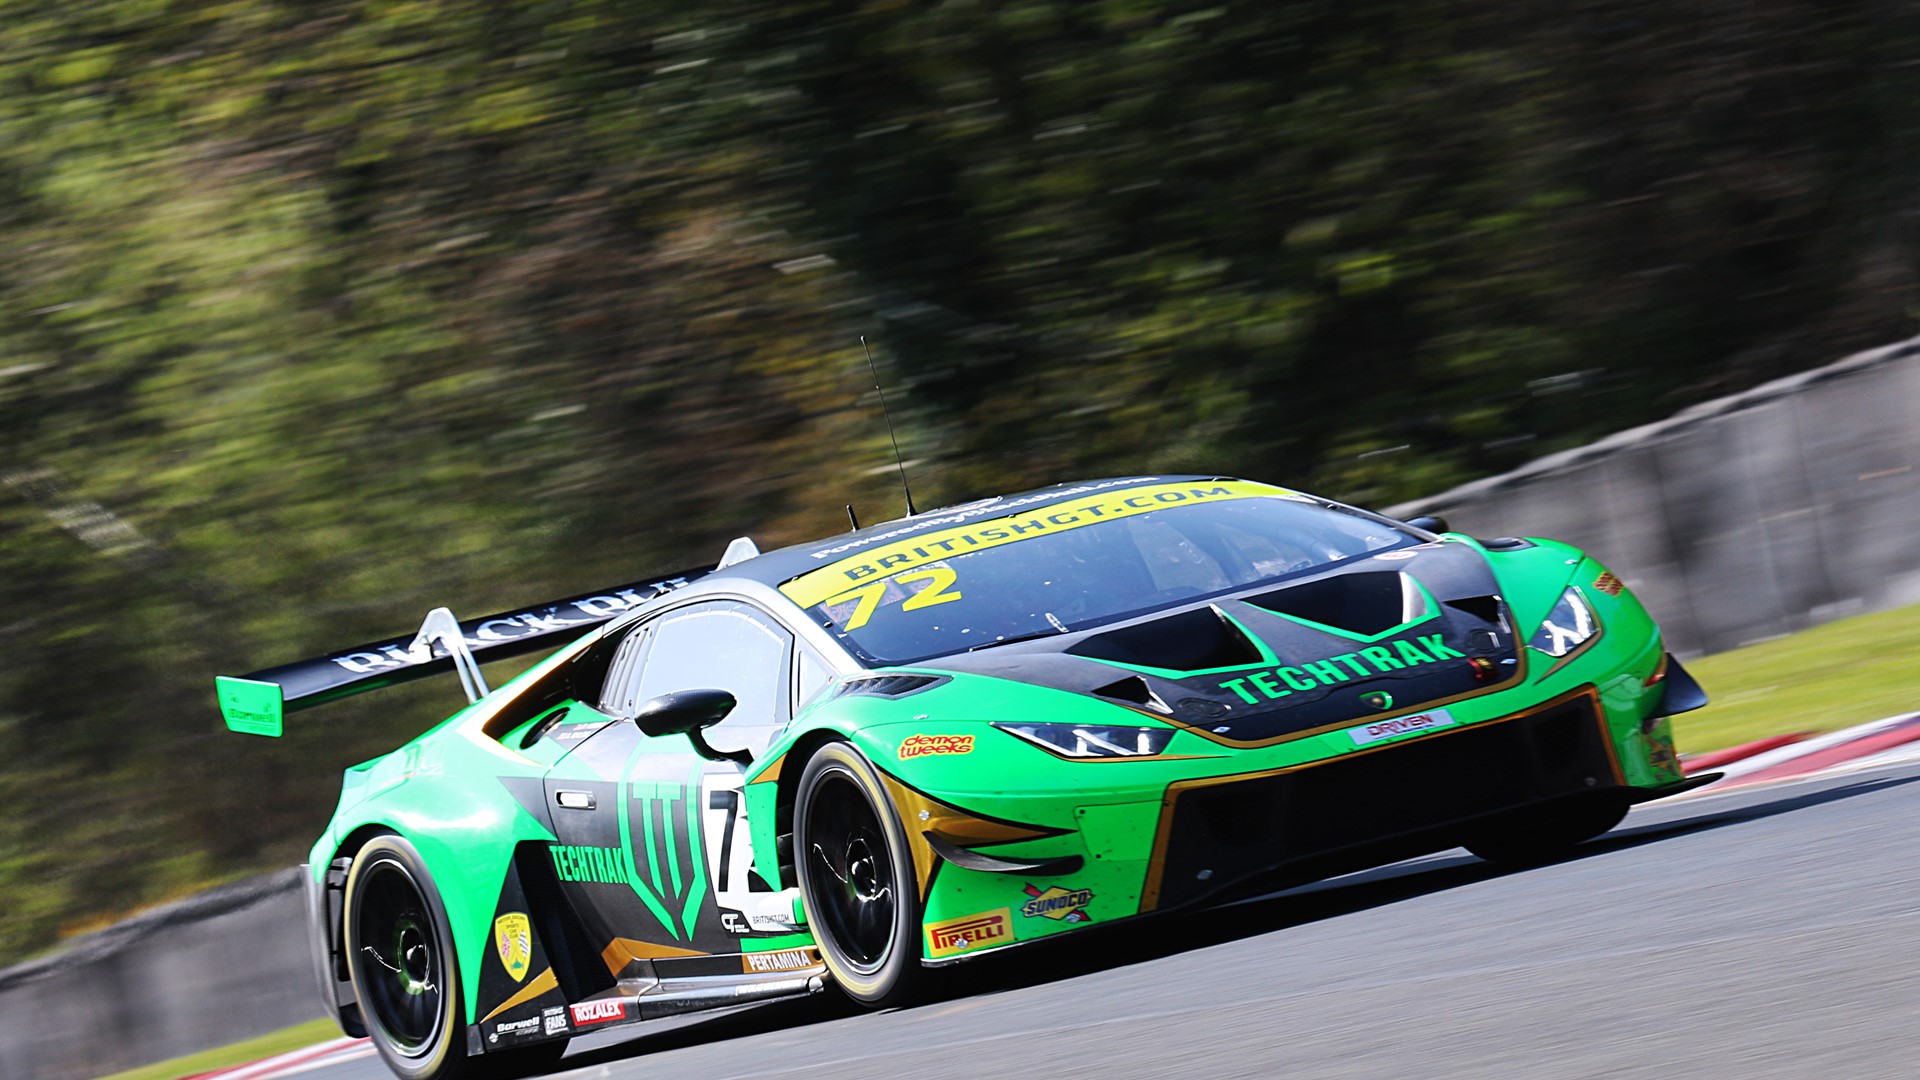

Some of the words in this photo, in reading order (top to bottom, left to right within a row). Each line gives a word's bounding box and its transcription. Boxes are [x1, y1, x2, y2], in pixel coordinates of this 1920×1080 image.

[843, 487, 1233, 581] BRITISHGT.COM
[825, 567, 962, 632] 72
[1218, 634, 1466, 705] TECHTRAK
[1366, 714, 1434, 736] DRIVEN
[900, 743, 972, 758] tweeks
[904, 735, 973, 747] demon
[549, 845, 628, 883] TECHTRAK
[1026, 892, 1089, 915] SUNOCO
[752, 913, 791, 925] BRITISHGT.COM
[931, 915, 1004, 949] PIRELLI
[747, 950, 812, 971] PERTAMINA
[545, 1014, 567, 1030] FANS
[574, 1001, 622, 1022] ROZALEX
[497, 1016, 540, 1033] Barwell
